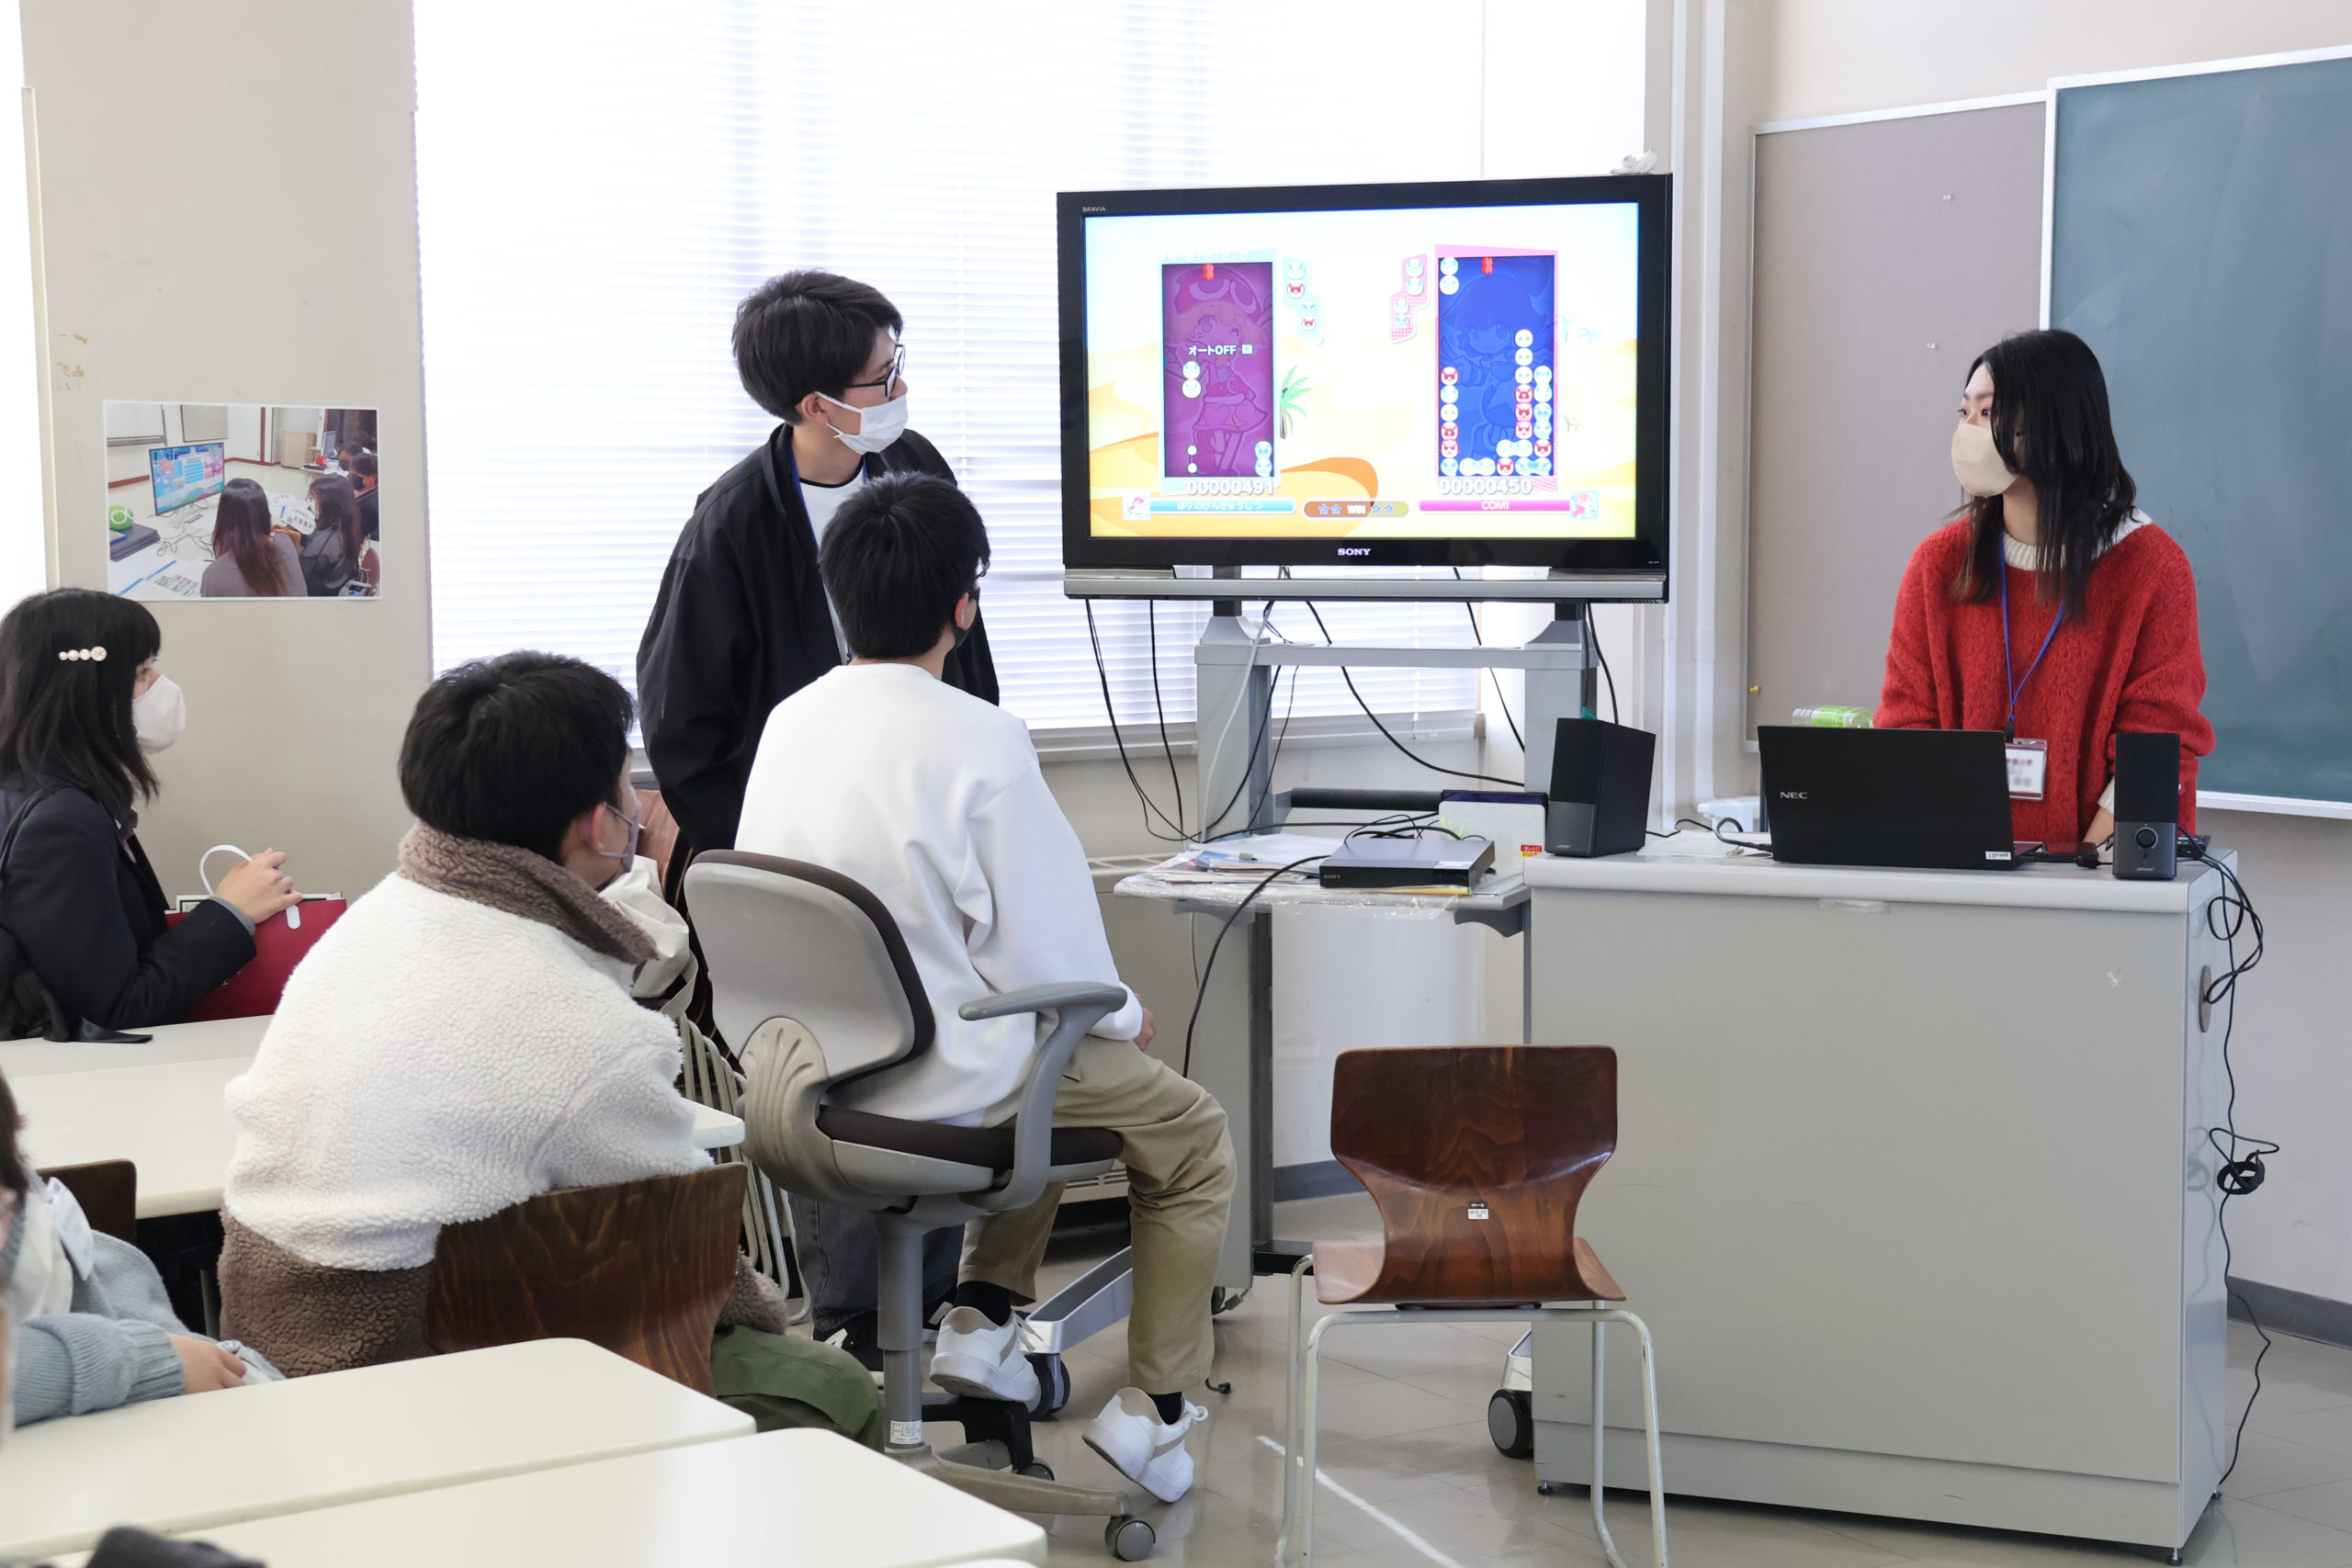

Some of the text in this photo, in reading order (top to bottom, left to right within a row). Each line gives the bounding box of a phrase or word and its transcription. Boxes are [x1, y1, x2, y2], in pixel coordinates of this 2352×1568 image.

[1188, 344, 1238, 356] オートOFF
[1186, 479, 1274, 496] 00000491
[1439, 478, 1533, 495] 00000450
[1338, 547, 1372, 556] SONY
[1780, 792, 1808, 800] NEC
